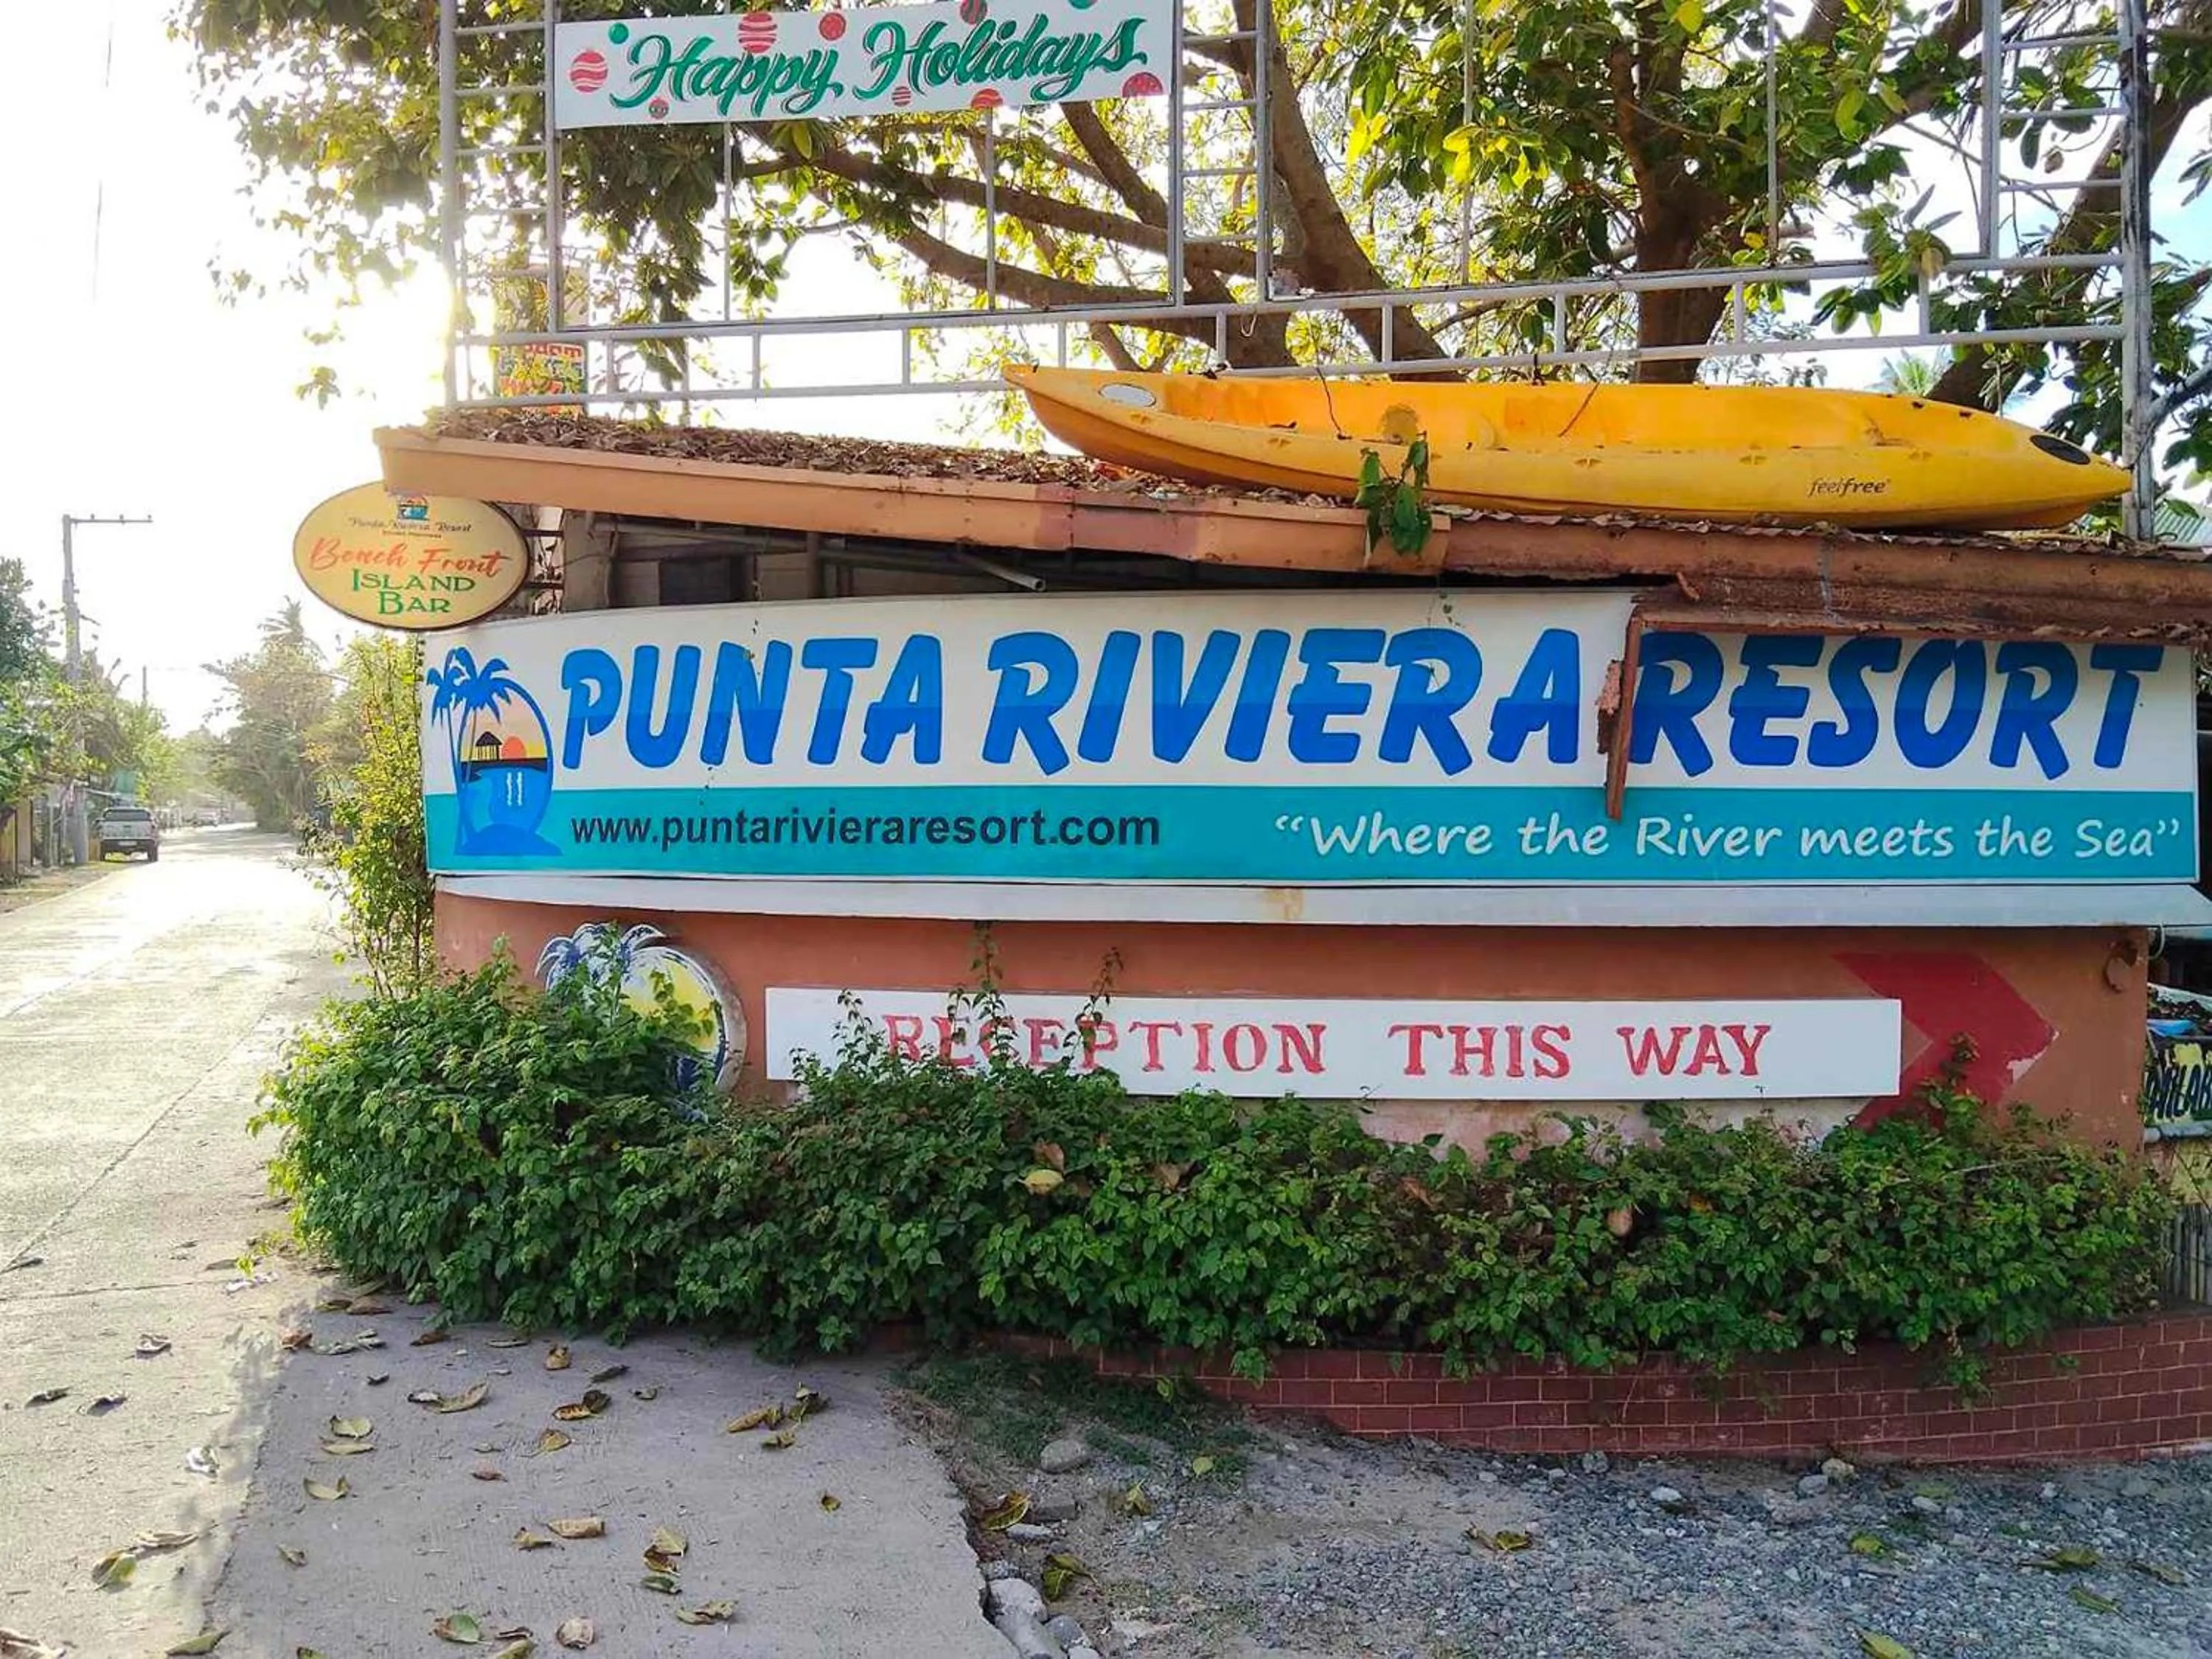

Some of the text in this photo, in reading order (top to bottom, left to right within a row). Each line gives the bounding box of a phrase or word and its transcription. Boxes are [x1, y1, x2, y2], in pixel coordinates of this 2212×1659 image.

[608, 13, 1148, 116] Happy Holidays
[352, 568, 476, 591] ISLAND
[419, 548, 514, 578] Front
[378, 591, 452, 615] BAR
[561, 628, 2166, 781] PUNTA RIVIERA RESORT
[570, 807, 1161, 851] www.puntarivieraresort.com
[1517, 815, 1610, 857] the
[1635, 813, 1781, 858] River
[1799, 818, 1955, 859] meets
[1974, 815, 2055, 859] the
[1387, 1023, 1571, 1079] THIS
[1615, 1023, 1772, 1077] WAY
